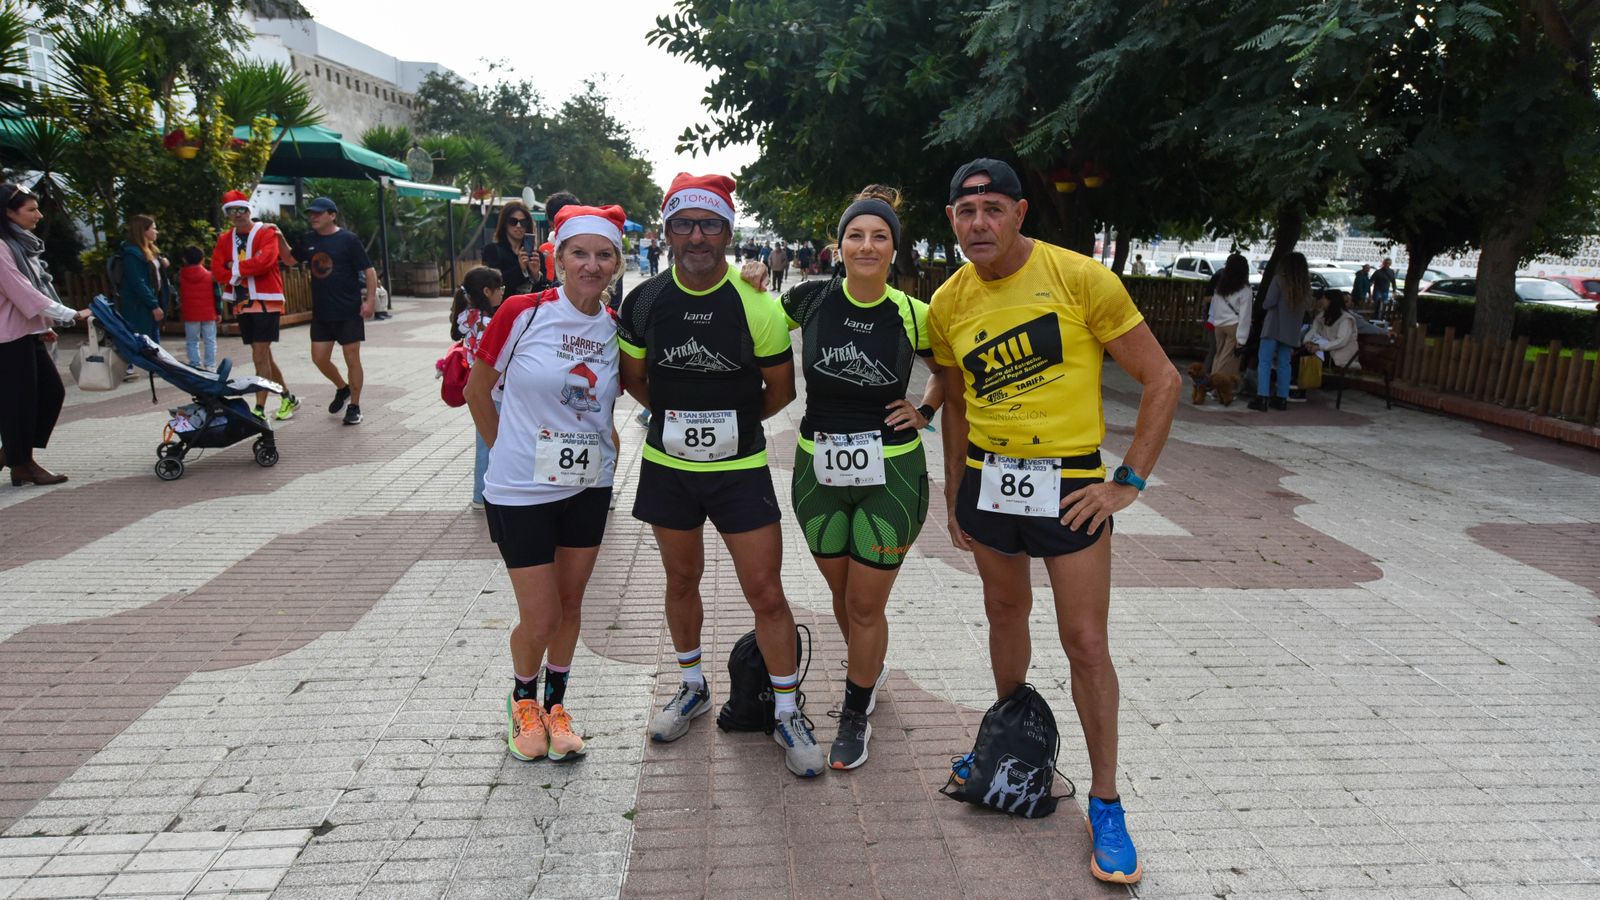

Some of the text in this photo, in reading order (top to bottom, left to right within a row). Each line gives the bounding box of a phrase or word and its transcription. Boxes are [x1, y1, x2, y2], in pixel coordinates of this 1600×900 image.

[683, 194, 720, 208] TOMAX
[684, 311, 713, 321] land
[843, 317, 874, 331] land
[977, 331, 1034, 373] XIII
[1015, 375, 1045, 391] TARIFA
[684, 426, 716, 448] 85
[558, 447, 590, 470] 84
[825, 448, 869, 471] 100
[1000, 473, 1035, 498] 86
